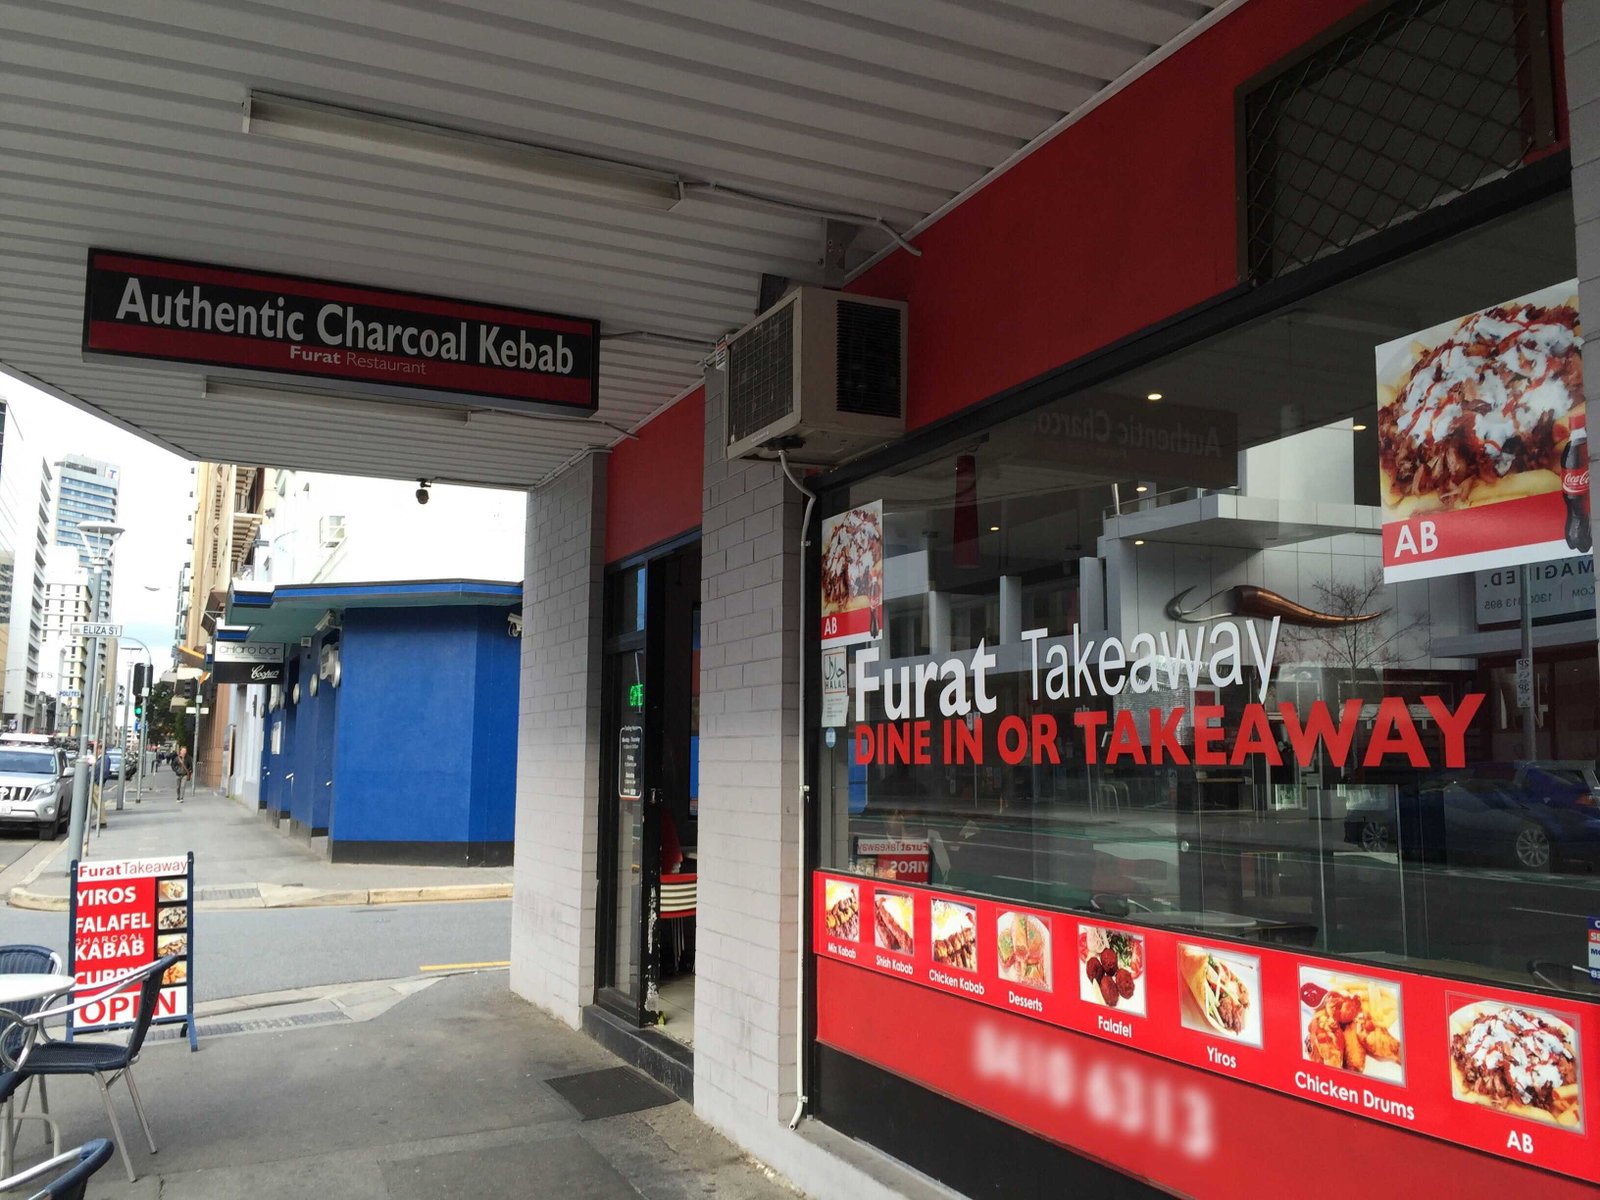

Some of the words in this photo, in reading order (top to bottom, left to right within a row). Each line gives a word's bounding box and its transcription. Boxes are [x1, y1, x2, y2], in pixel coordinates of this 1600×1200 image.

[116, 277, 304, 341] Authentic
[316, 303, 467, 361] Charcoal
[479, 324, 574, 374] Kebab
[290, 345, 341, 365] Furat
[346, 352, 427, 375] Restaurant
[1394, 521, 1438, 558] AB
[83, 625, 107, 634] ELIZA
[824, 617, 838, 636] AB
[855, 637, 997, 722] Furat
[1021, 615, 1281, 704] Takeaway
[629, 684, 643, 706] OPE
[825, 679, 846, 690] HALAL
[855, 720, 932, 765] DINE
[943, 718, 983, 765] IN
[997, 713, 1061, 765] OR
[1074, 693, 1486, 768] TAKEAWAY
[77, 886, 137, 907] YIROS
[76, 912, 151, 934] FALAFEL
[75, 933, 144, 946] CHARCOAL
[75, 940, 145, 961] KABAB
[827, 942, 838, 953] Mix
[838, 945, 856, 959] Kabab
[876, 955, 891, 968] Shish
[892, 959, 913, 975] Kabab
[928, 969, 958, 988] Chicken
[960, 978, 985, 995] Kabab
[1008, 990, 1043, 1013] Desserts
[1098, 1015, 1133, 1038] Falafel
[1206, 1046, 1237, 1069] Yiros
[1294, 1071, 1358, 1104] Chicken
[1364, 1089, 1415, 1121] Drums
[1507, 1130, 1534, 1154] AB
